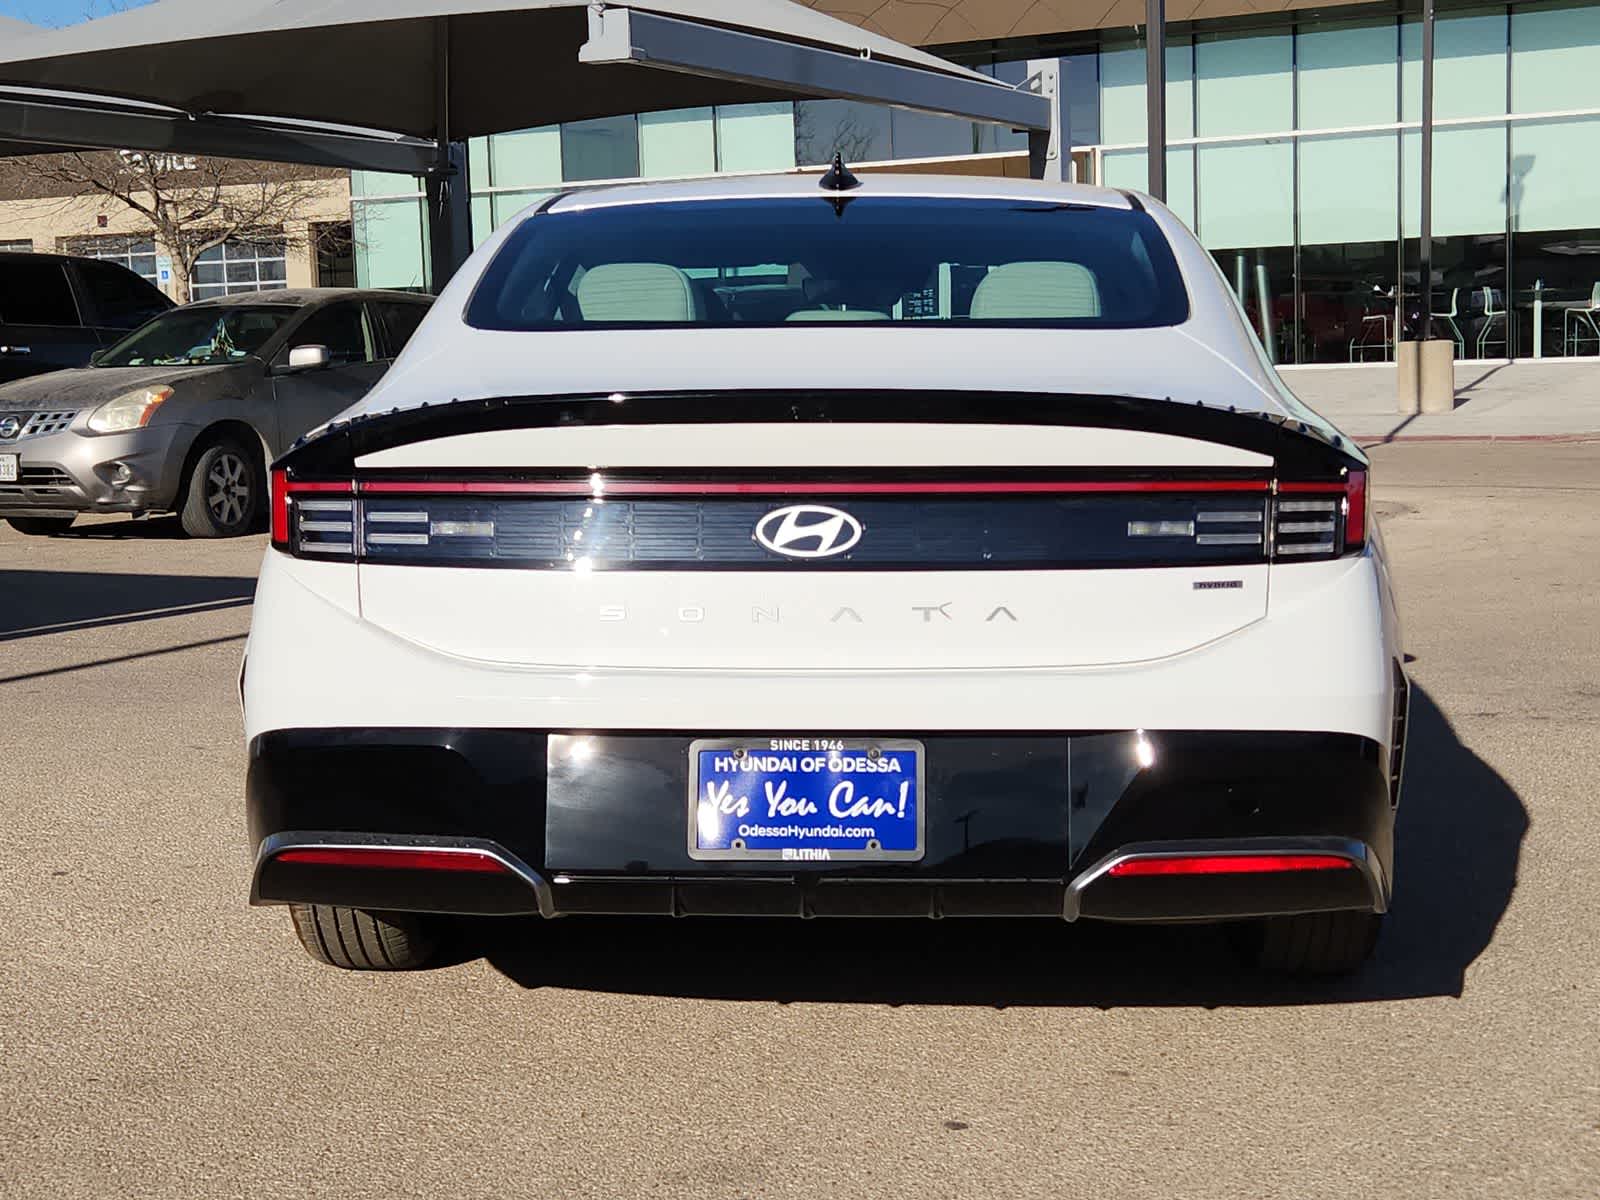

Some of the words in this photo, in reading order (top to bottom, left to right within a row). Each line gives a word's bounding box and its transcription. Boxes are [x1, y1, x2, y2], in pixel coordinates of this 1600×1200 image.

[599, 602, 1018, 622] SONATA
[770, 739, 810, 751] SINCE
[813, 739, 845, 751] 1946
[714, 756, 797, 773] HYUNDAI
[800, 757, 826, 773] OF
[828, 757, 902, 773] ODESSA
[706, 780, 750, 818] Yes
[764, 780, 818, 818] You
[828, 780, 910, 819] Can!
[738, 825, 876, 840] OdessaHyundai.com
